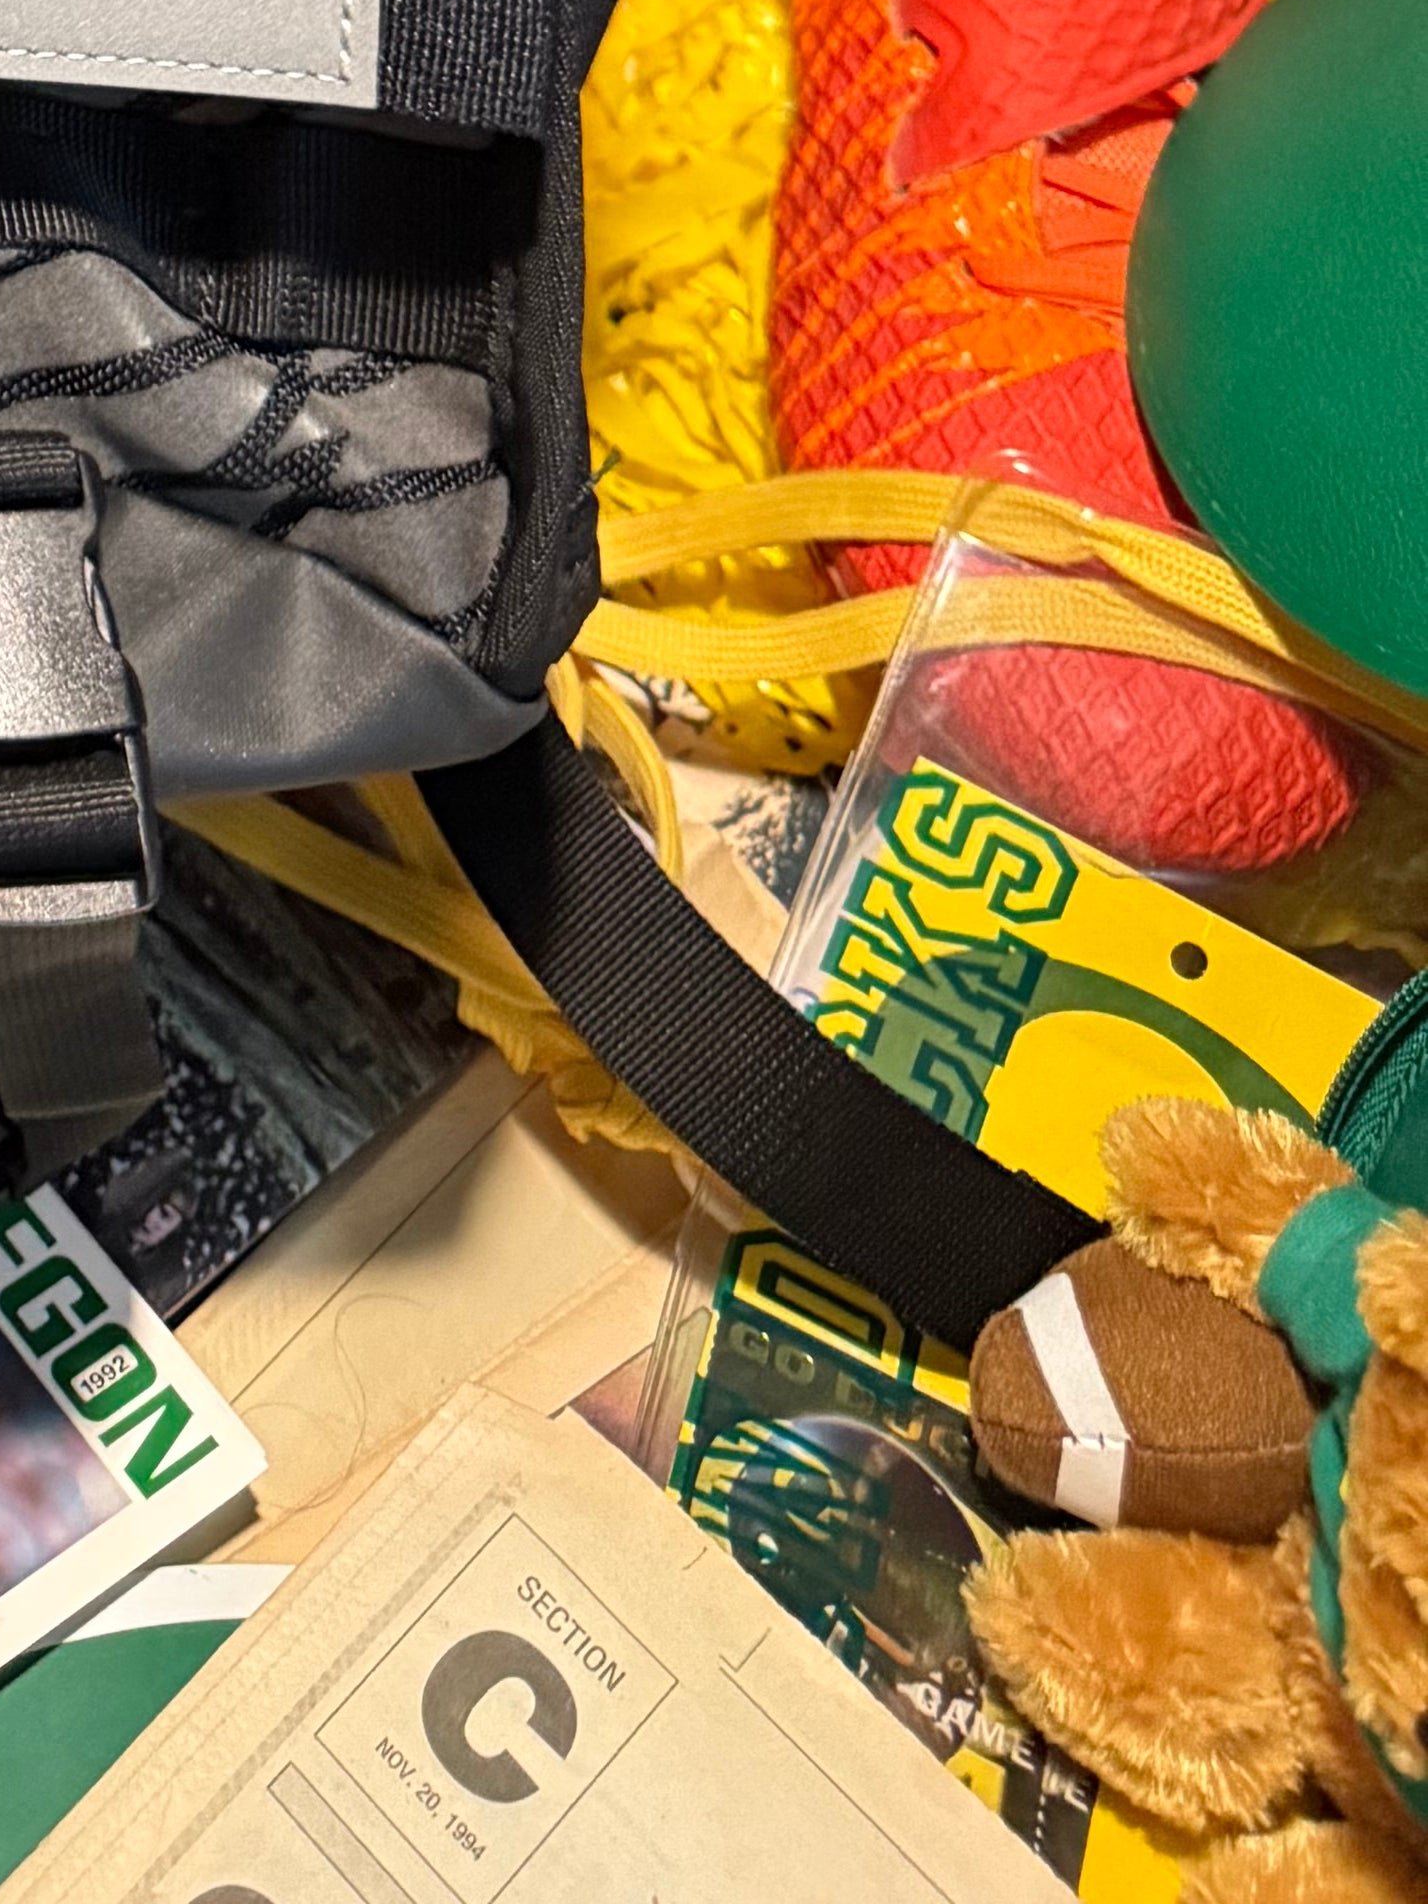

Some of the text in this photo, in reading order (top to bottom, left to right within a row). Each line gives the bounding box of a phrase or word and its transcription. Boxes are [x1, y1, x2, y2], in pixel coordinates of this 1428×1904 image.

[79, 1353, 131, 1396] 1992
[729, 1320, 816, 1386] GO
[515, 1574, 628, 1693] SECTION
[420, 1628, 579, 1805] C
[374, 1735, 487, 1862] NOV. 20, 1994
